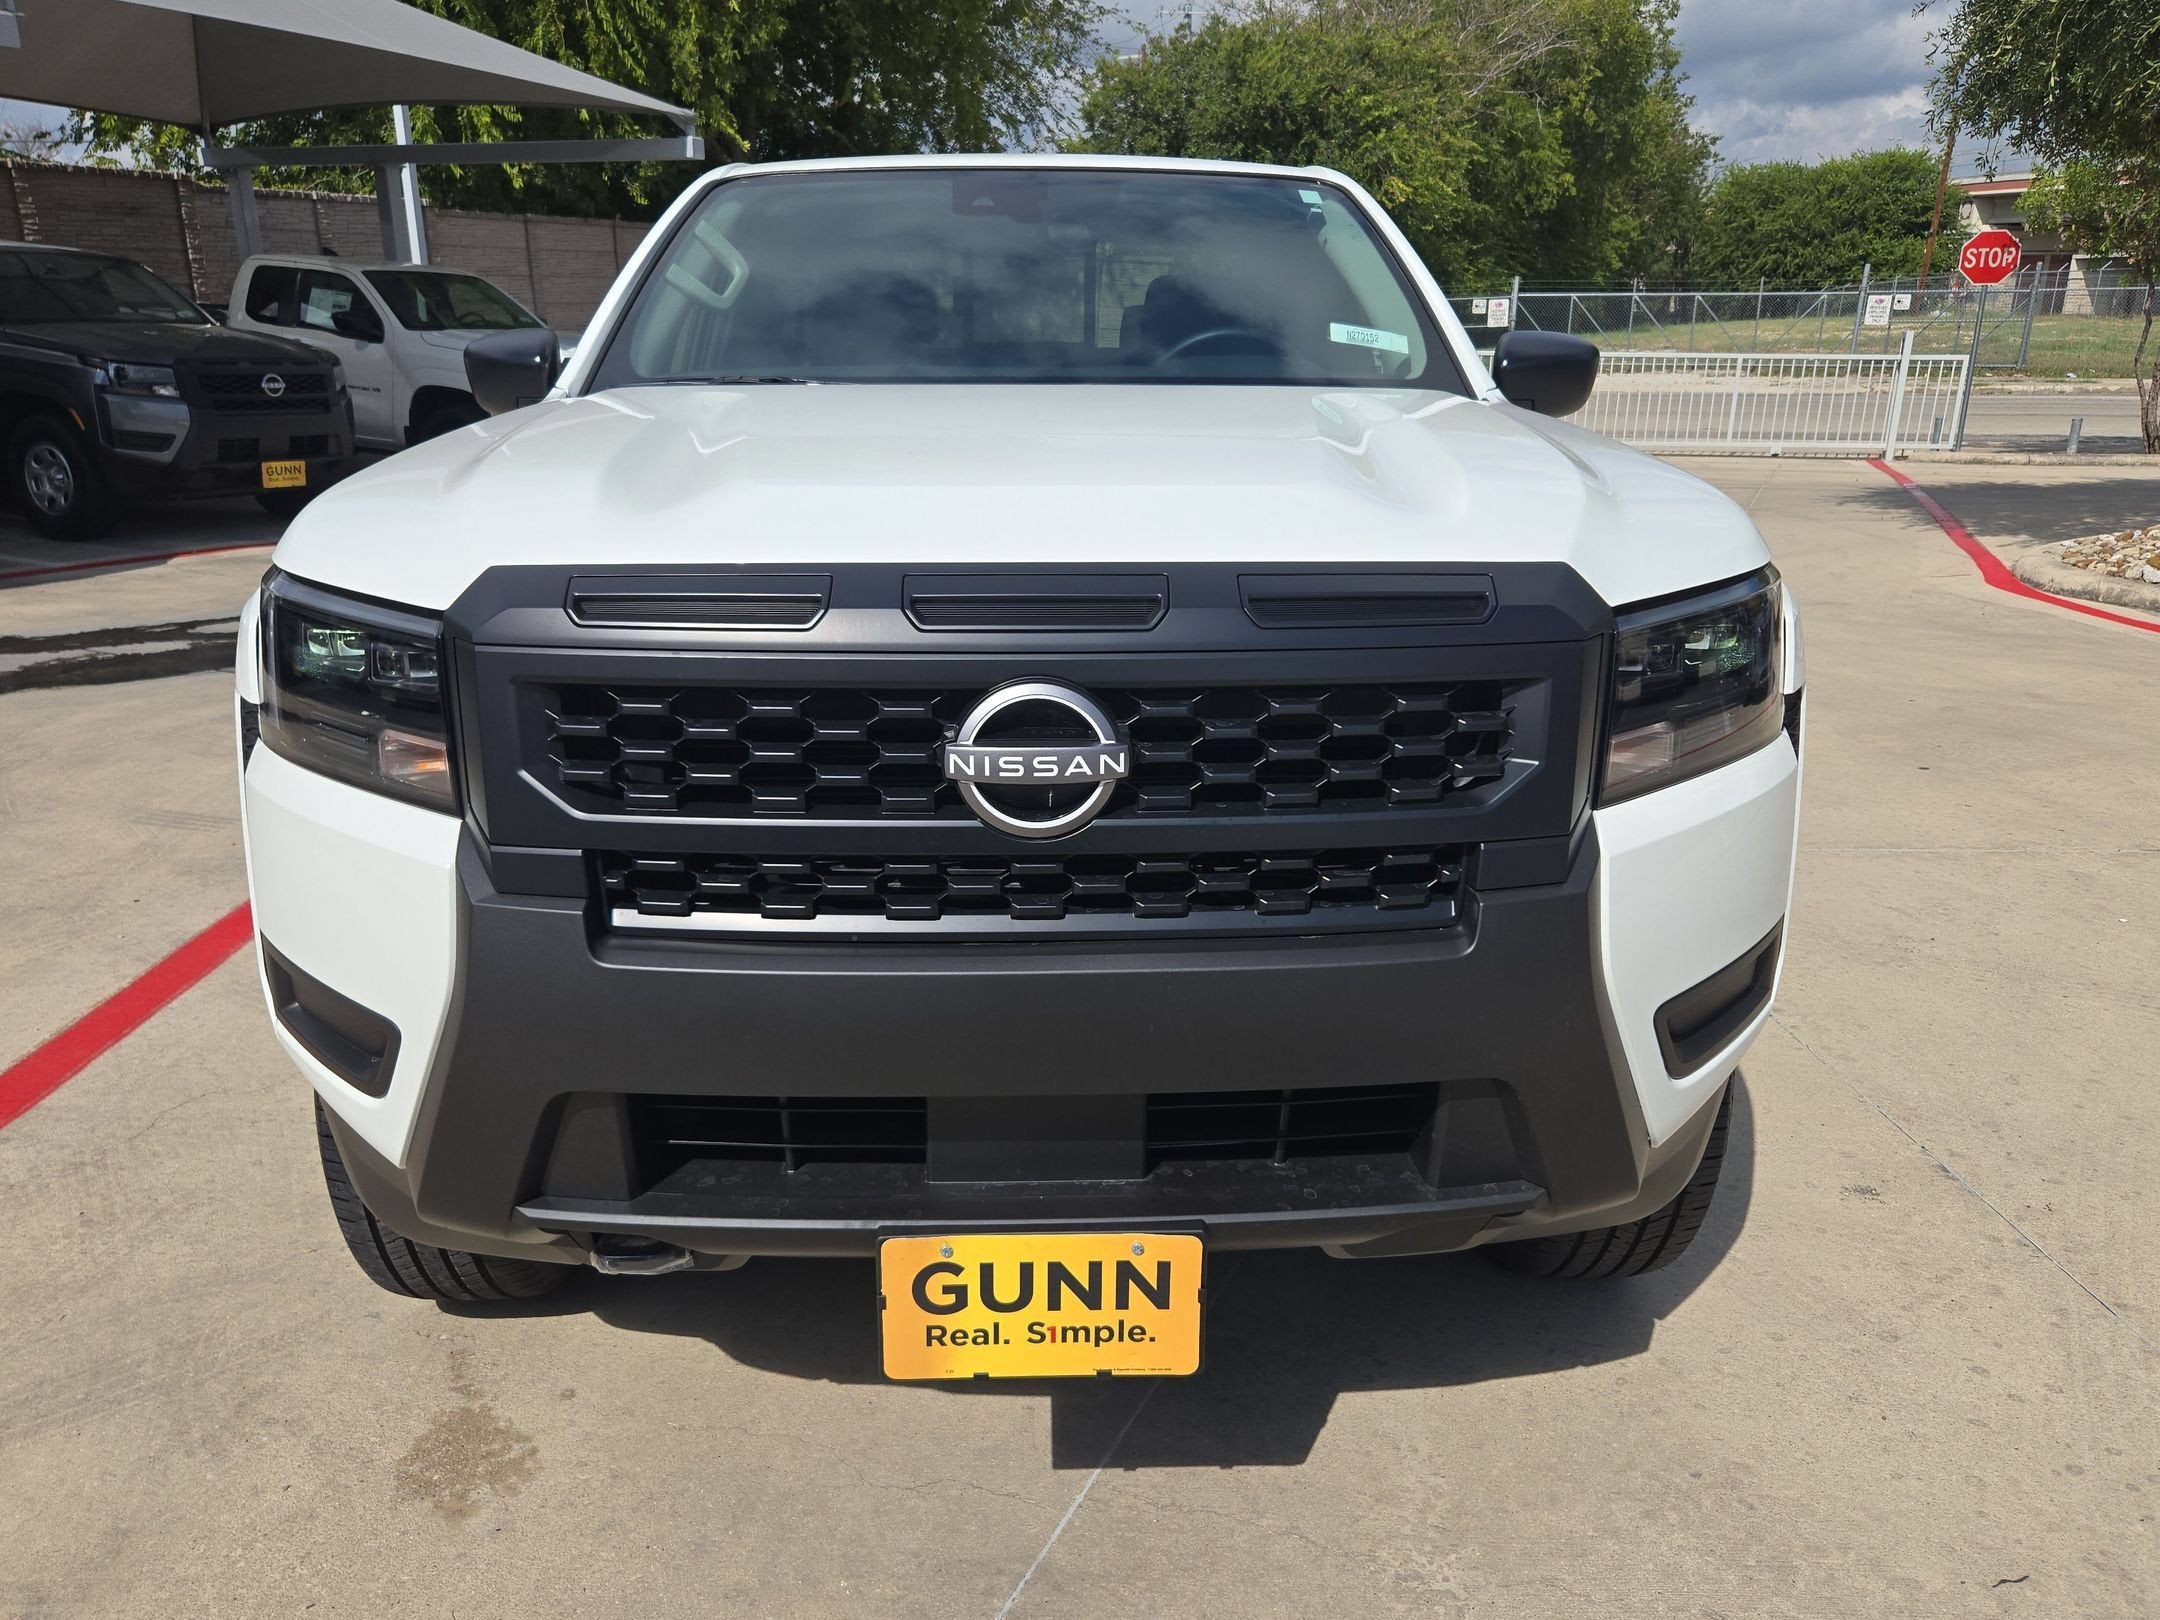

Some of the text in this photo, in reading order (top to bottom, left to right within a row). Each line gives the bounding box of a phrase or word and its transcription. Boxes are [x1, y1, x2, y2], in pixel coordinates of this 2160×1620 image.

[1963, 247, 2017, 269] STOP
[266, 464, 302, 477] GUNN
[949, 752, 1125, 777] NISSAN
[911, 1259, 1172, 1316] GUNN
[925, 1321, 1011, 1347] Real.
